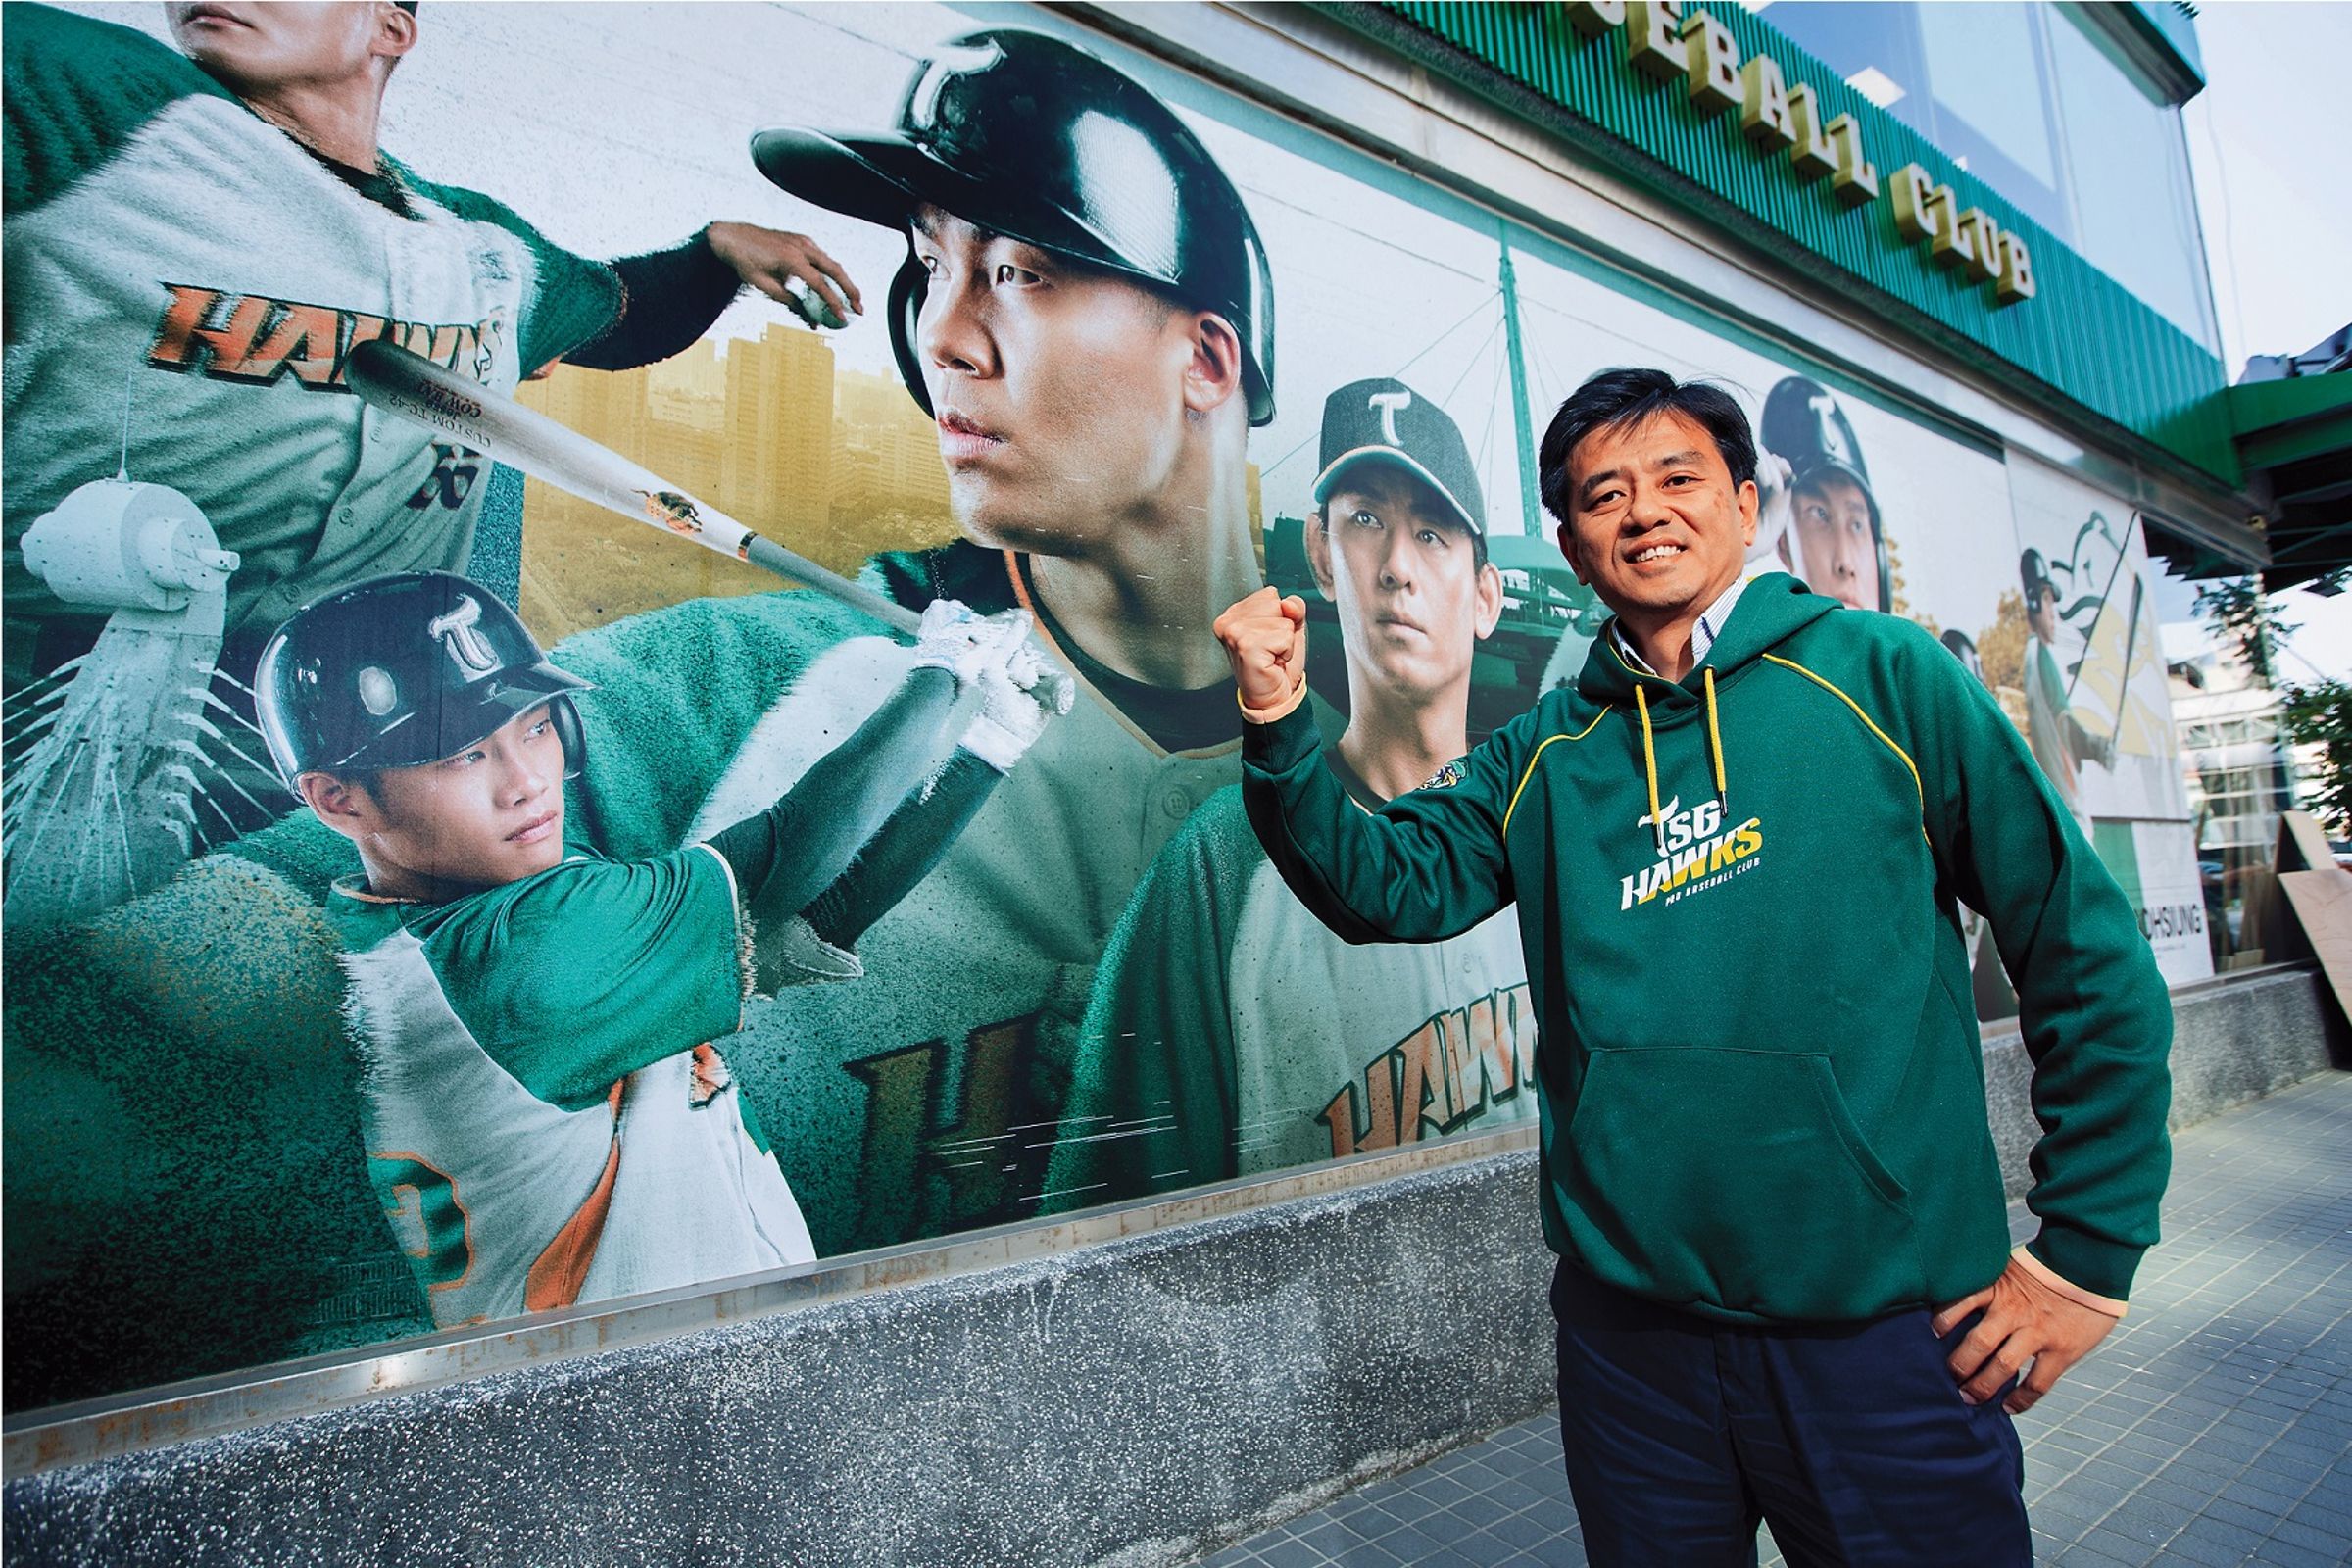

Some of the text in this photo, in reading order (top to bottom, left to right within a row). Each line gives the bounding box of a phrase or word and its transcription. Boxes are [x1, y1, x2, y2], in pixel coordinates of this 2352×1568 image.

[1565, 2, 2036, 306] EBALL CLUB
[1368, 388, 1412, 446] T
[428, 592, 503, 678] T
[1638, 794, 1722, 858] TSG
[1620, 817, 1763, 910] HAWKS
[1665, 857, 1761, 906] PRO BASEBALL CLUB
[2134, 904, 2202, 941] OHSIUNG
